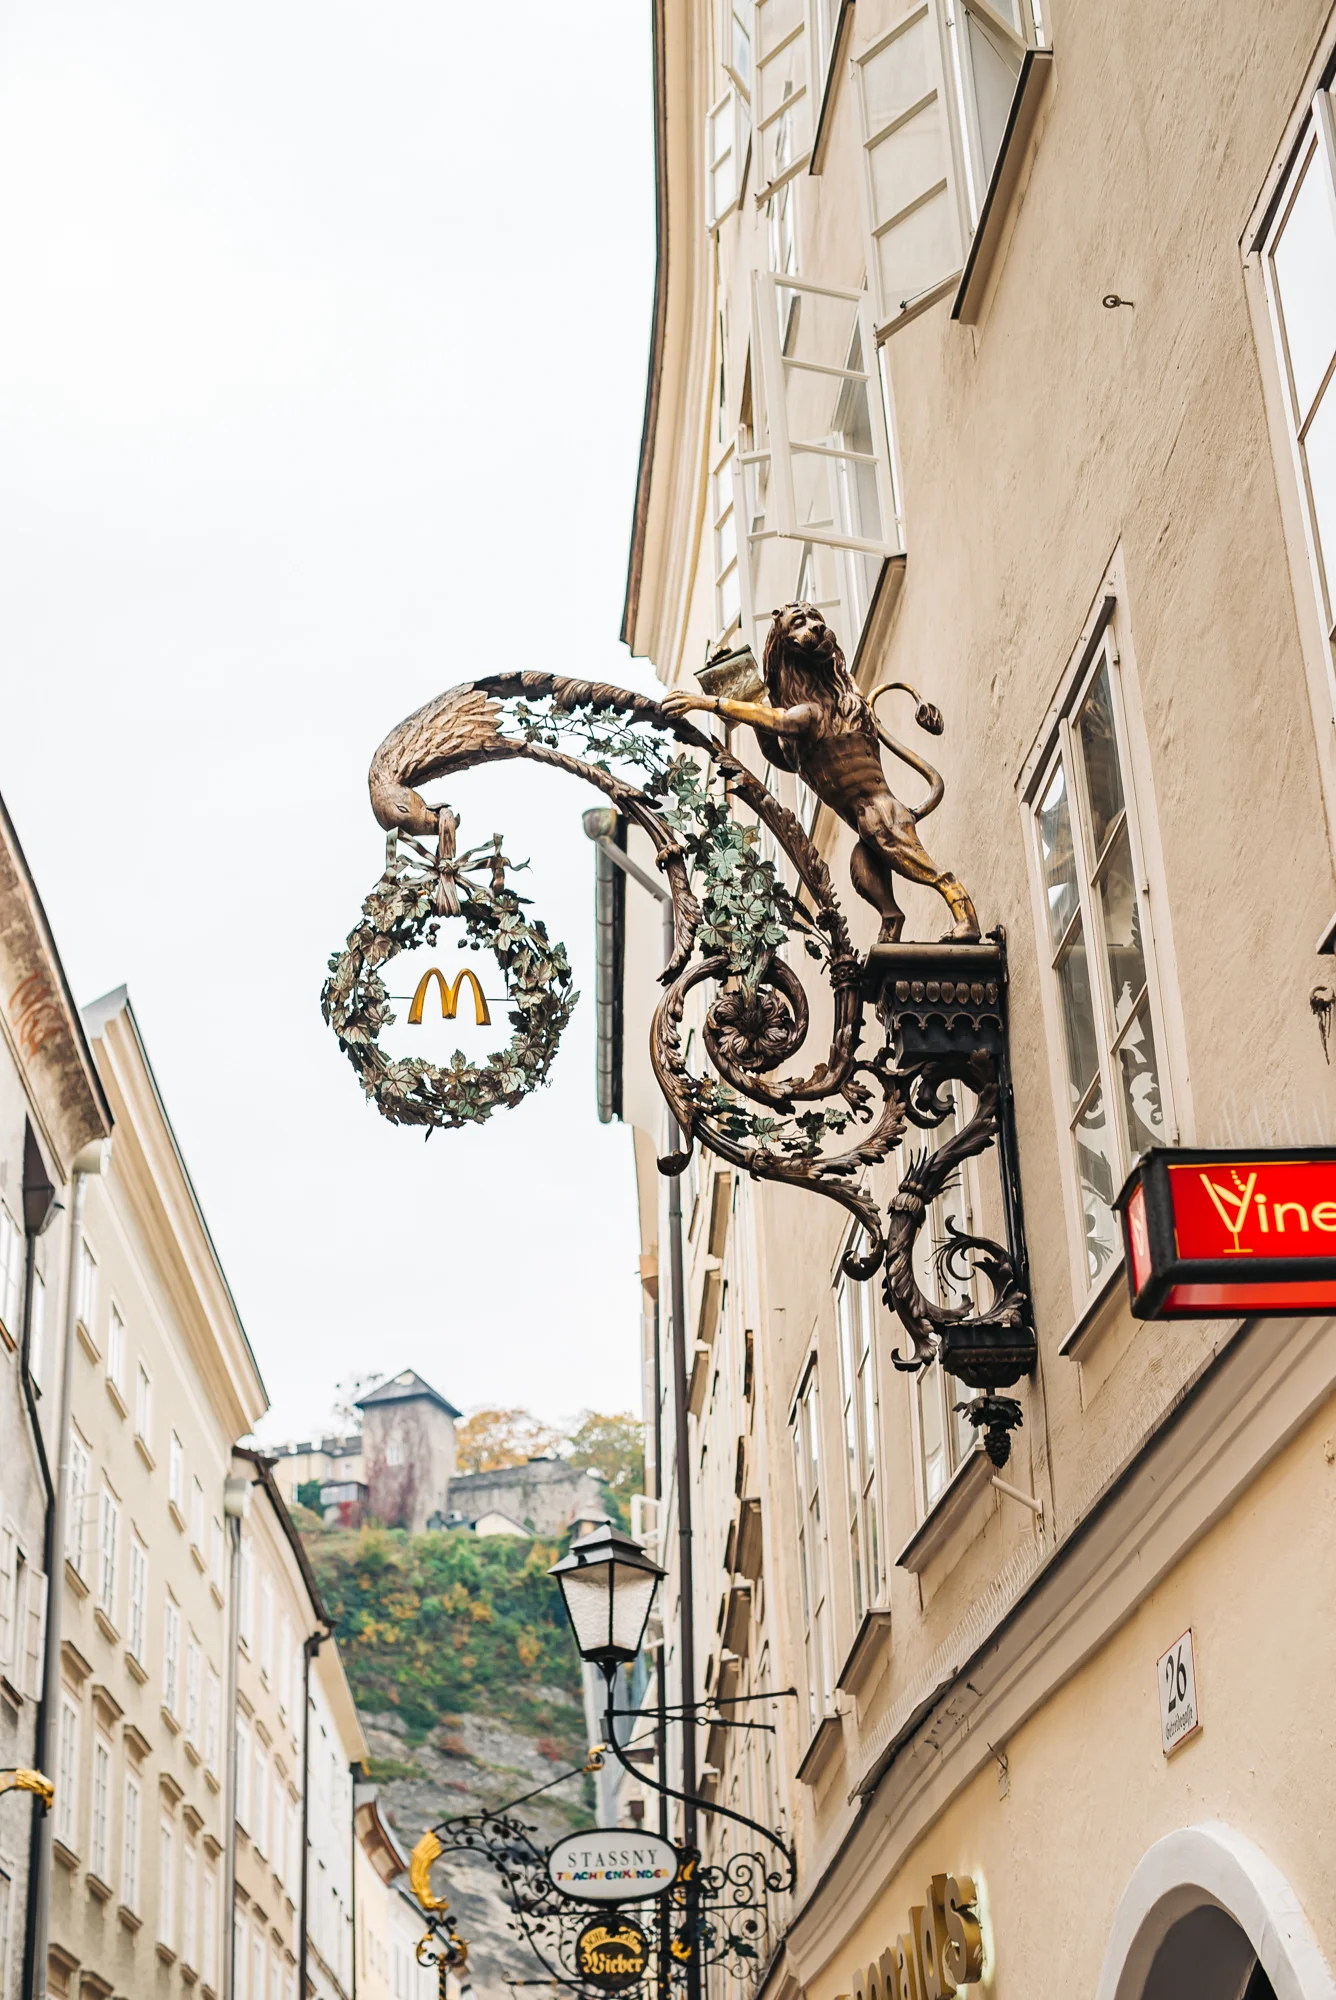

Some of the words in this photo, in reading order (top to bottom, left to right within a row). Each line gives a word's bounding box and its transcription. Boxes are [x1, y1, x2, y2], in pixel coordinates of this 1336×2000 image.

[407, 966, 491, 1025] M
[1199, 1170, 1336, 1253] Vine
[1165, 1644, 1187, 1713] 26
[567, 1849, 659, 1868] STASSNY
